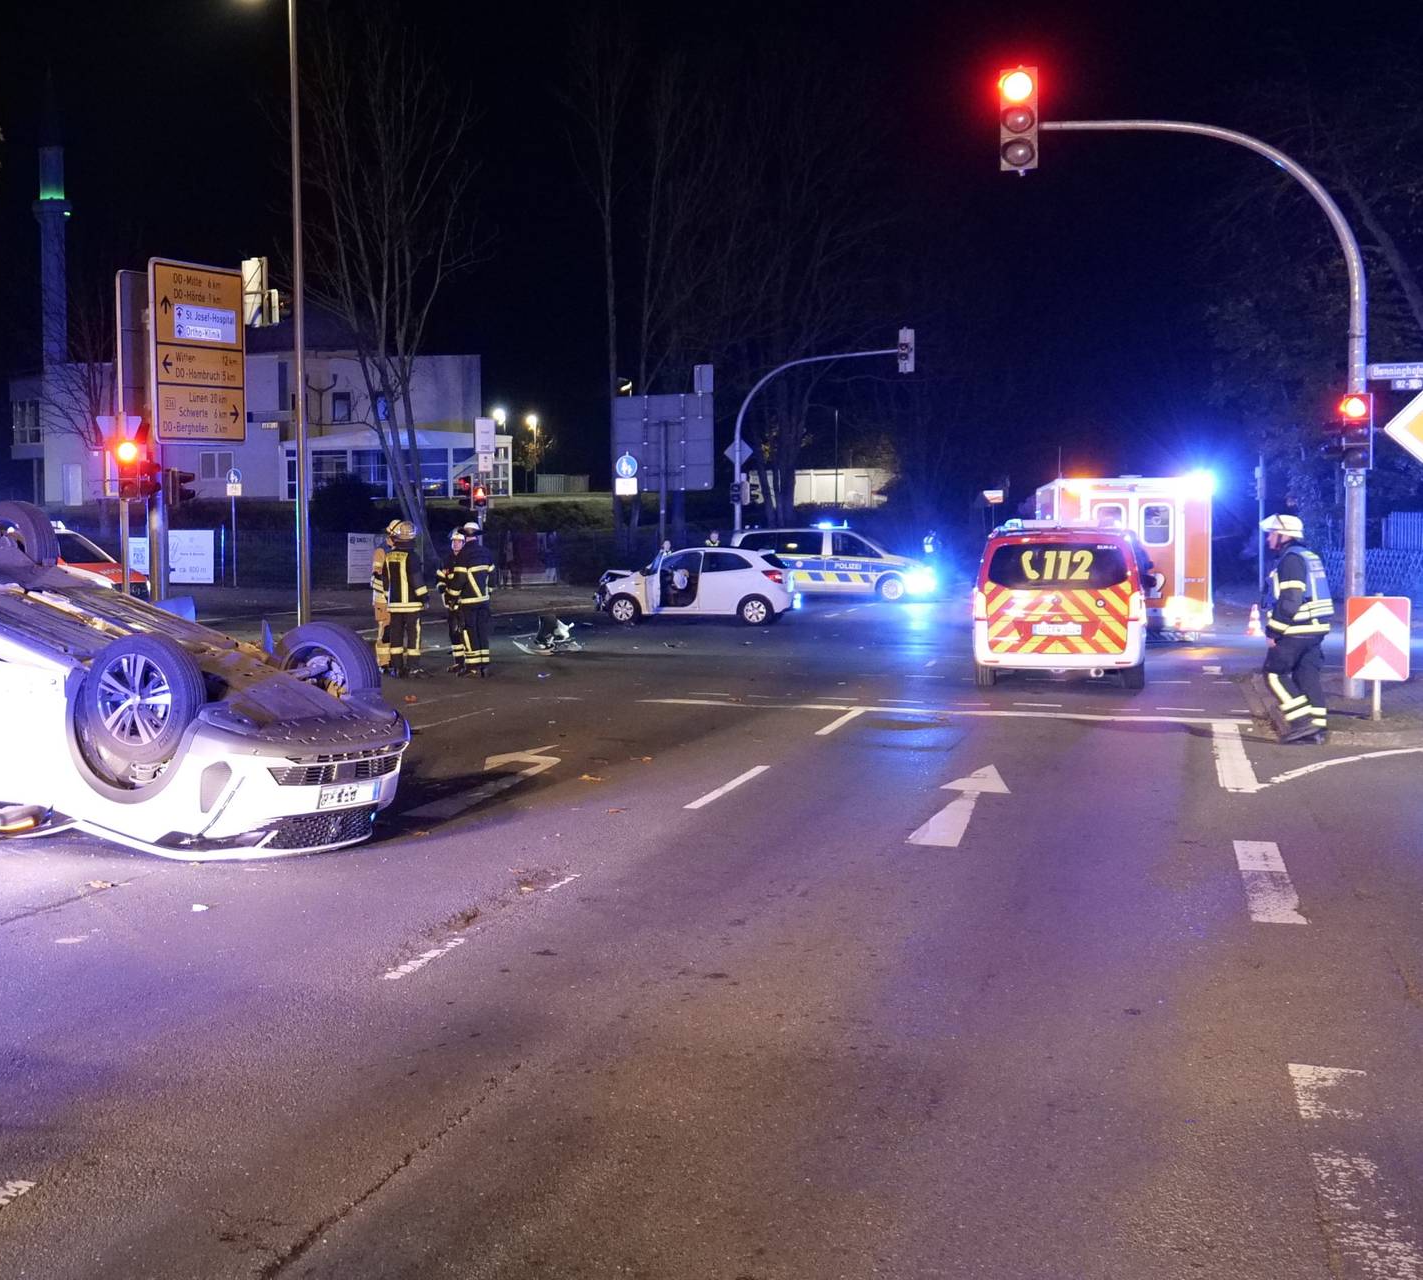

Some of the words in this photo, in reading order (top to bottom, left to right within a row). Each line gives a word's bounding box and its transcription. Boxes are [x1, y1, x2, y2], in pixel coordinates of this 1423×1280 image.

[195, 312, 234, 325] Josef-Hospital
[178, 406, 208, 418] Schwerte
[162, 420, 209, 435] DO-Berghofen
[1044, 550, 1094, 580] 112
